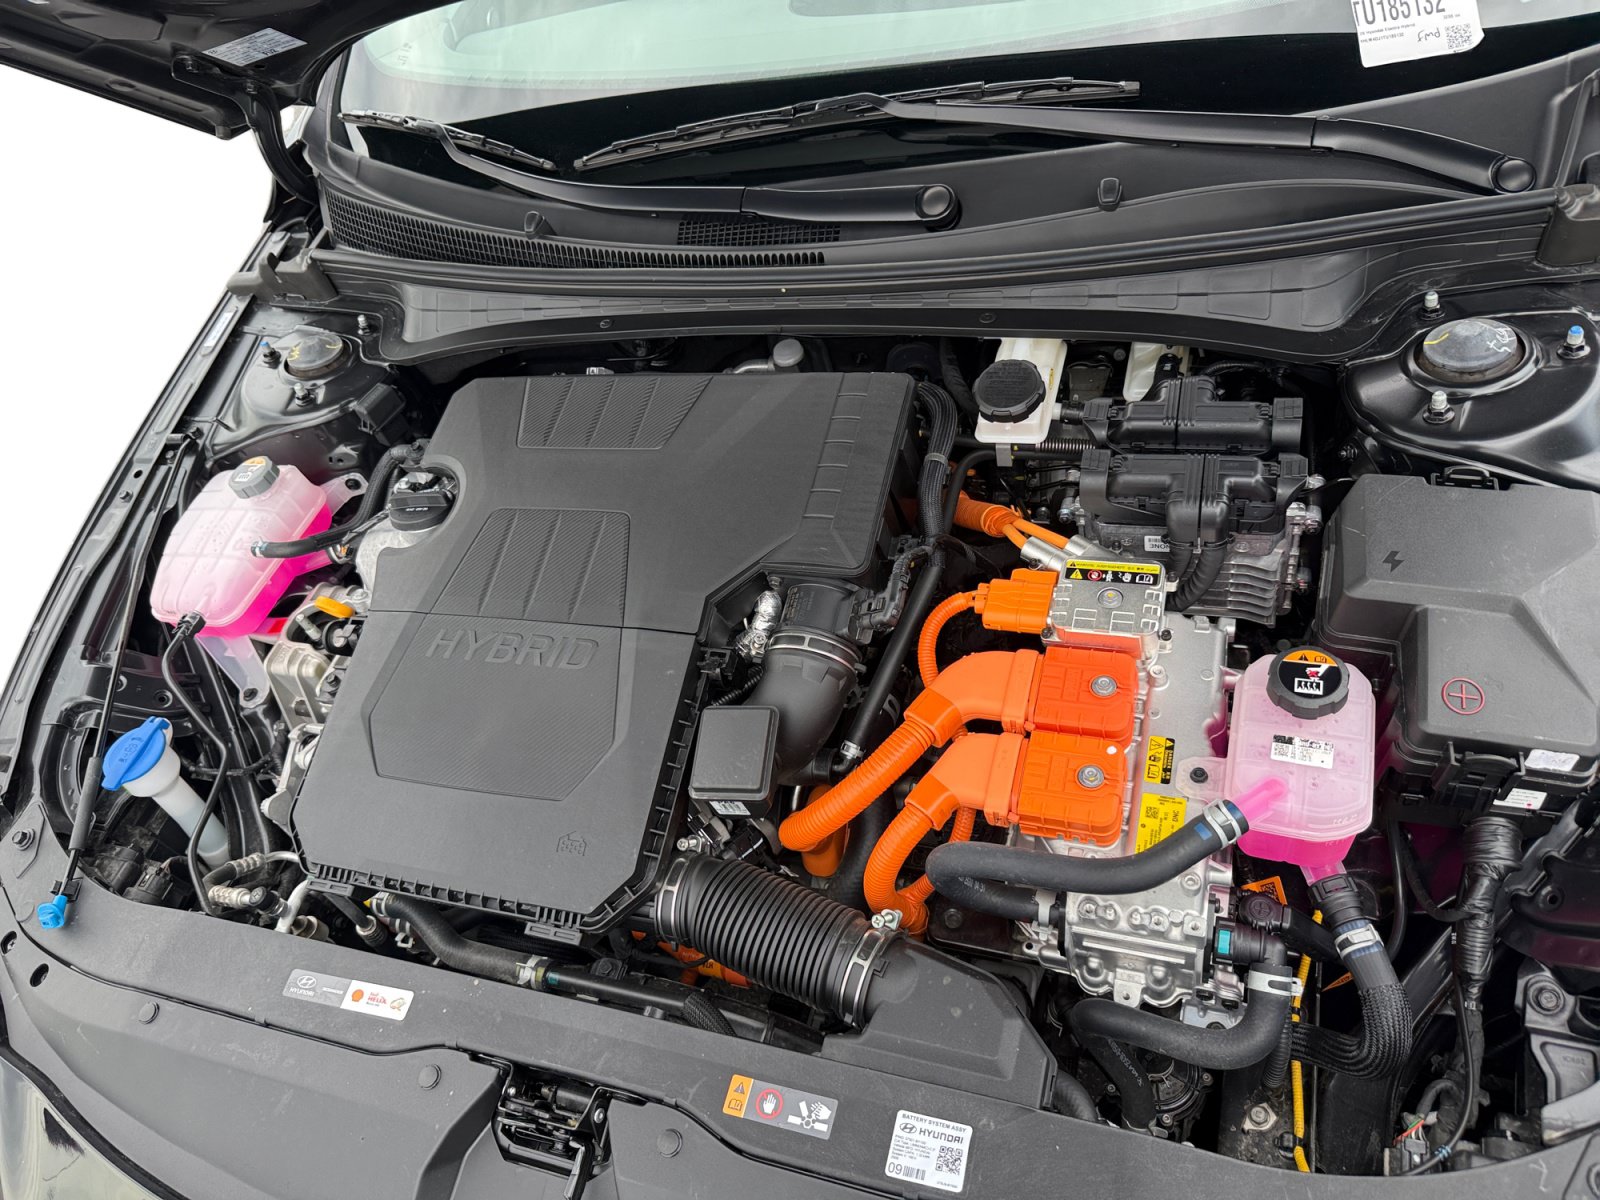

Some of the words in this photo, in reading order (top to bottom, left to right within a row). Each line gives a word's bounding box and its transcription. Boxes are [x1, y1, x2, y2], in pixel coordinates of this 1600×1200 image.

[425, 628, 600, 670] HYBRID
[289, 986, 315, 997] HYUNDAI
[902, 1113, 927, 1124] BATTERY
[928, 1120, 950, 1129] SYSTEM
[951, 1125, 967, 1133] ASSY
[919, 1128, 963, 1144] HYUNDAI
[888, 1161, 903, 1175] 09
